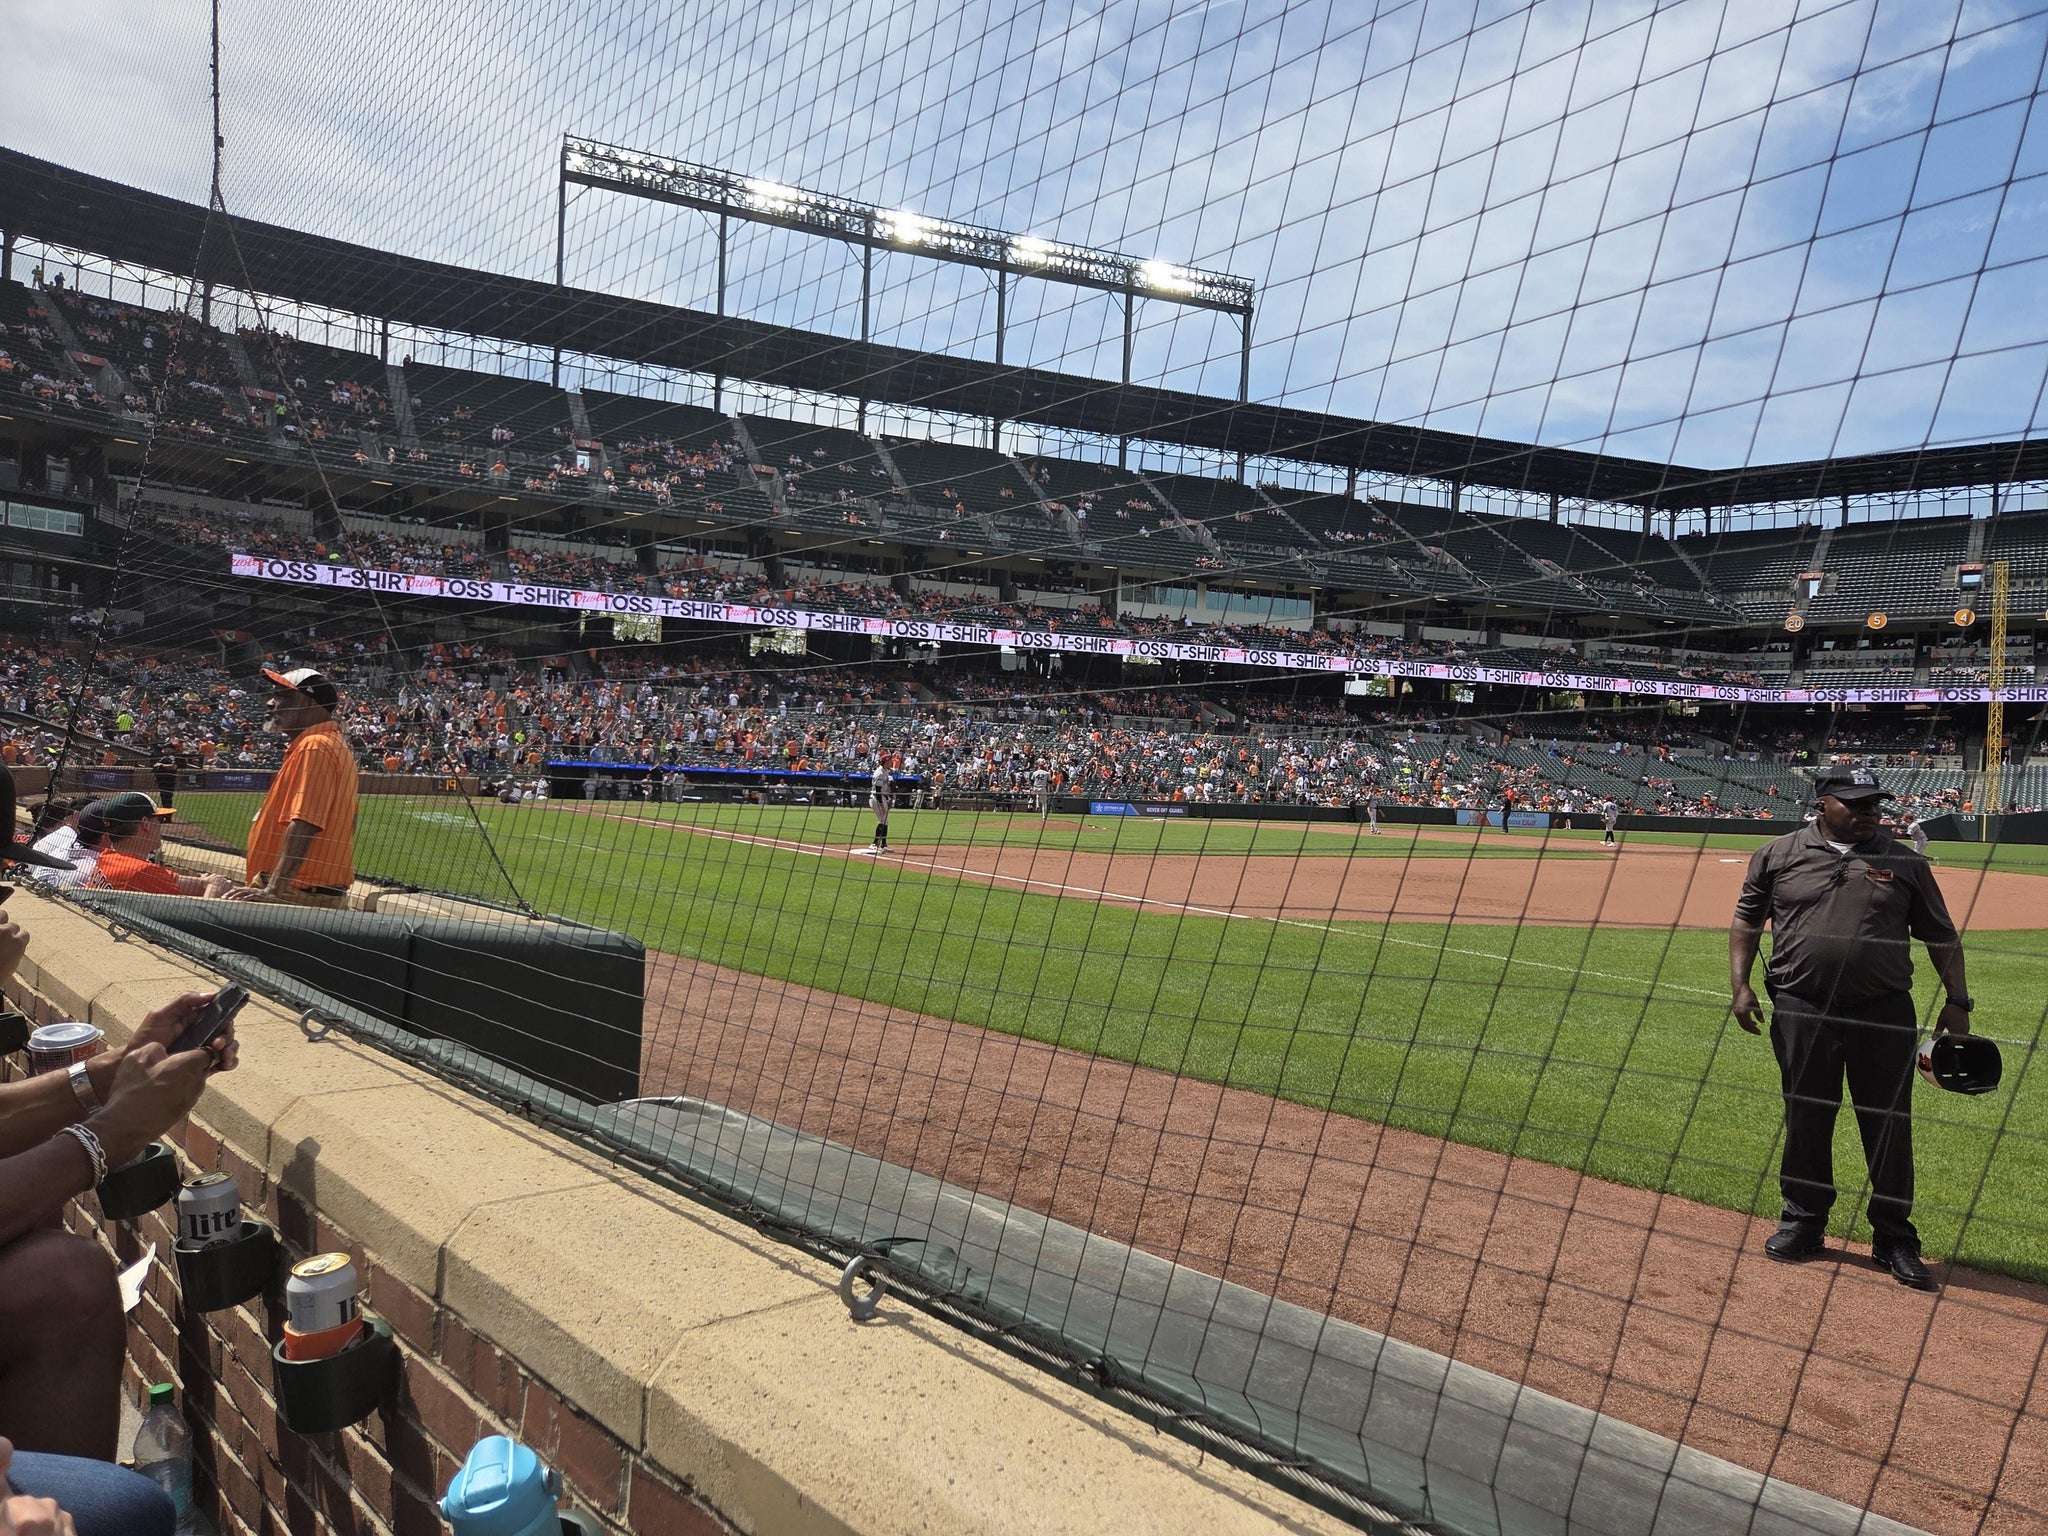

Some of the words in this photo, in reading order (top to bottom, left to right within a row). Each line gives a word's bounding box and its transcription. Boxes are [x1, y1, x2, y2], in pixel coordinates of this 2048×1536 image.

[1874, 616, 1881, 625] 5
[1959, 614, 1967, 622] 4
[254, 558, 317, 581] TOSS
[328, 567, 415, 592] T-SHIRT
[436, 579, 493, 599] TOSS
[503, 585, 584, 606] T-SHIRT
[601, 594, 652, 613] TOSS
[662, 600, 733, 620] T-SHIRT
[751, 608, 797, 626] TOSS
[806, 613, 871, 632] T-SHIRT
[885, 620, 929, 637] TOSS
[937, 626, 996, 643] T-SHIRT
[1012, 631, 1053, 648] TOSS
[1059, 636, 1116, 652] T-SHIRT
[1130, 641, 1168, 656] TOSS
[1175, 645, 1229, 661] T-SHIRT
[1241, 649, 1277, 665] TOSS
[1283, 653, 1333, 669] T-SHIRT
[1346, 658, 1380, 673] TOSS
[1386, 661, 1433, 677] T-SHIRT
[1445, 666, 1477, 680] TOSS
[1483, 669, 1528, 684] T-SHIRT
[1539, 673, 1569, 687] TOSS
[1575, 676, 1618, 690] T-SHIRT
[1628, 680, 1657, 693] TOSS
[1662, 683, 1702, 696] T-SHIRT
[1712, 686, 1739, 699] TOSS
[1744, 689, 1790, 701] T-SHIRT
[1805, 690, 1847, 701] TOSS
[1855, 689, 1918, 701] T-SHIRT
[1935, 689, 1981, 701] TOSS
[1989, 689, 2048, 701] T-SHIR
[1787, 619, 1802, 629] 20
[446, 779, 457, 791] 19
[188, 1208, 237, 1241] Lite
